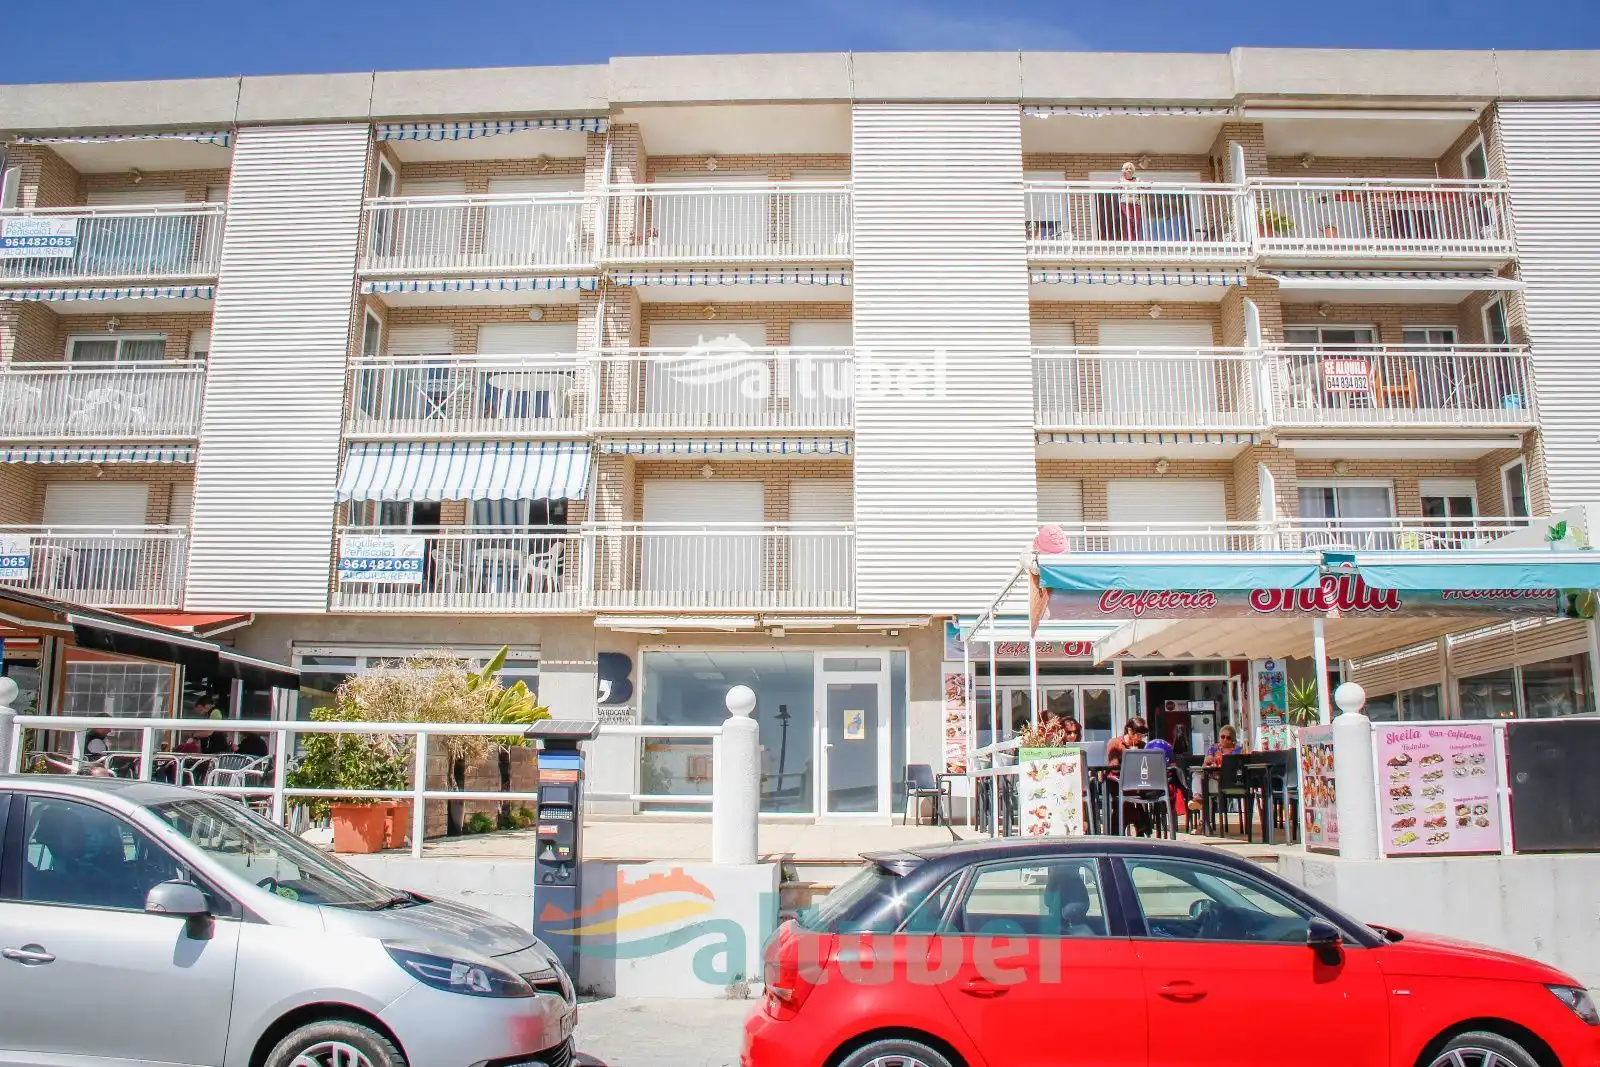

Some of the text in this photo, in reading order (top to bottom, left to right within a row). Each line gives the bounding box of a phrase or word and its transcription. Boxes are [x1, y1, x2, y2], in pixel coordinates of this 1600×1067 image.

[5, 237, 72, 247] 964482065
[1324, 361, 1367, 376] SE ALQUILA
[1327, 377, 1340, 389] 644
[0, 557, 26, 567] 065
[344, 559, 419, 570] 964482065
[1386, 729, 1421, 745] Sheila
